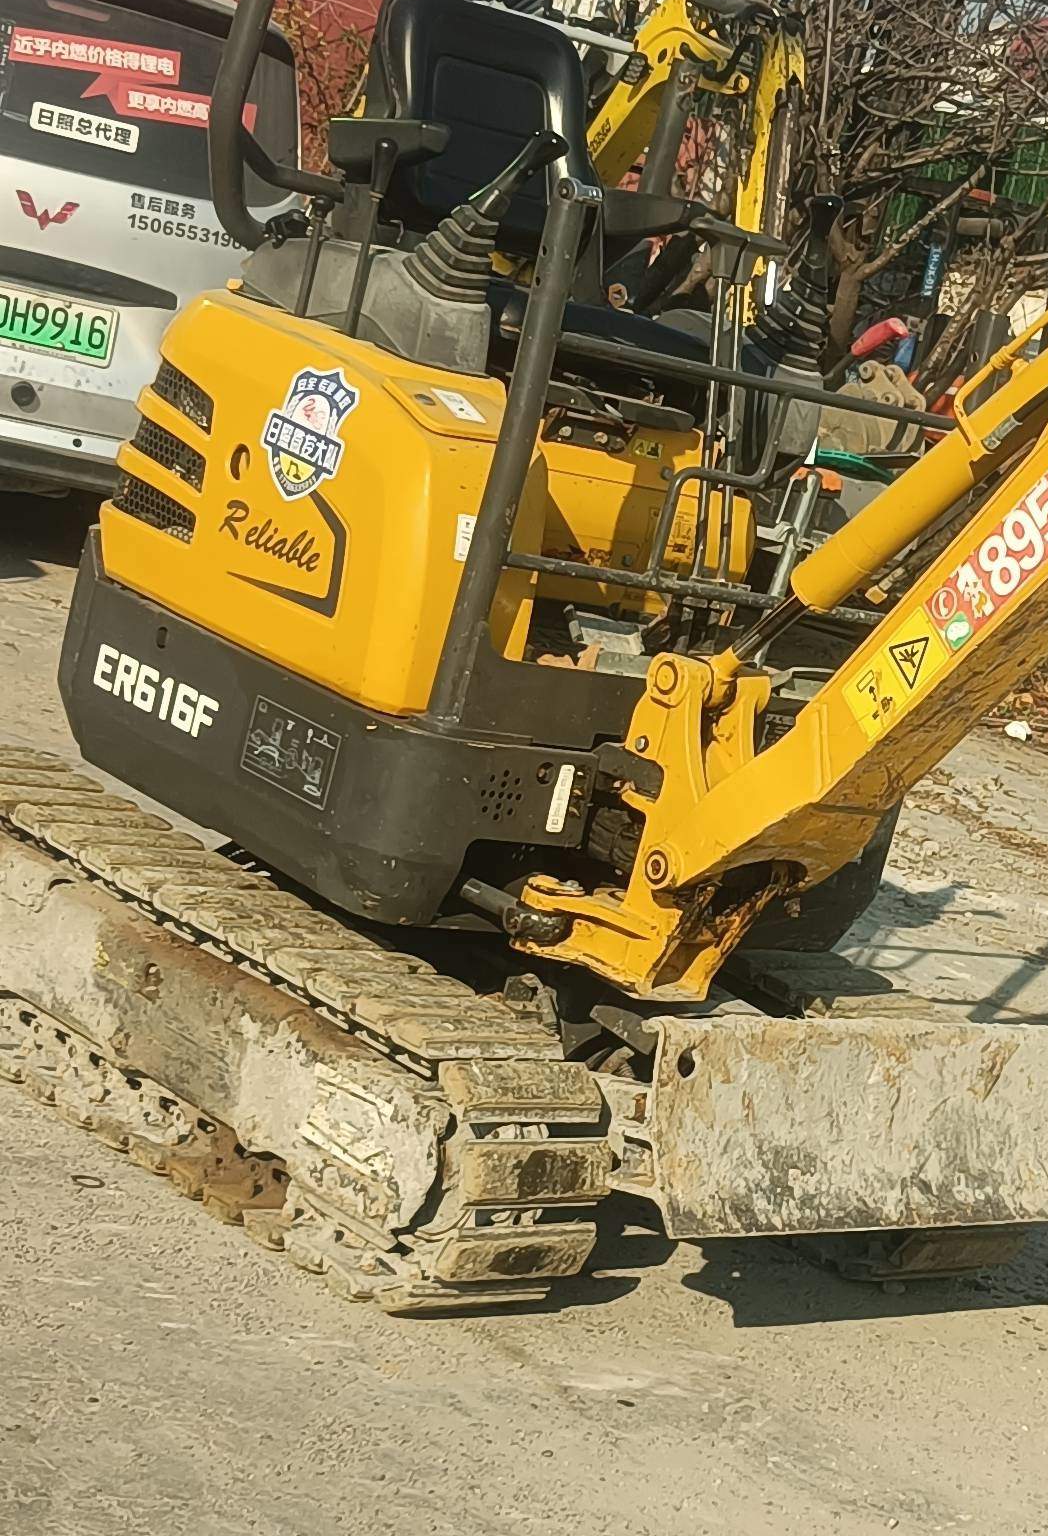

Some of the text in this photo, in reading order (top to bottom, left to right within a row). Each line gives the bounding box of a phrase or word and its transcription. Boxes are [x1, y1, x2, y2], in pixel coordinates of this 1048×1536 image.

[38, 107, 133, 146] 日照总代理
[130, 192, 196, 220] 售后服务
[218, 499, 321, 573] Reliable
[93, 643, 220, 738] ER616F
